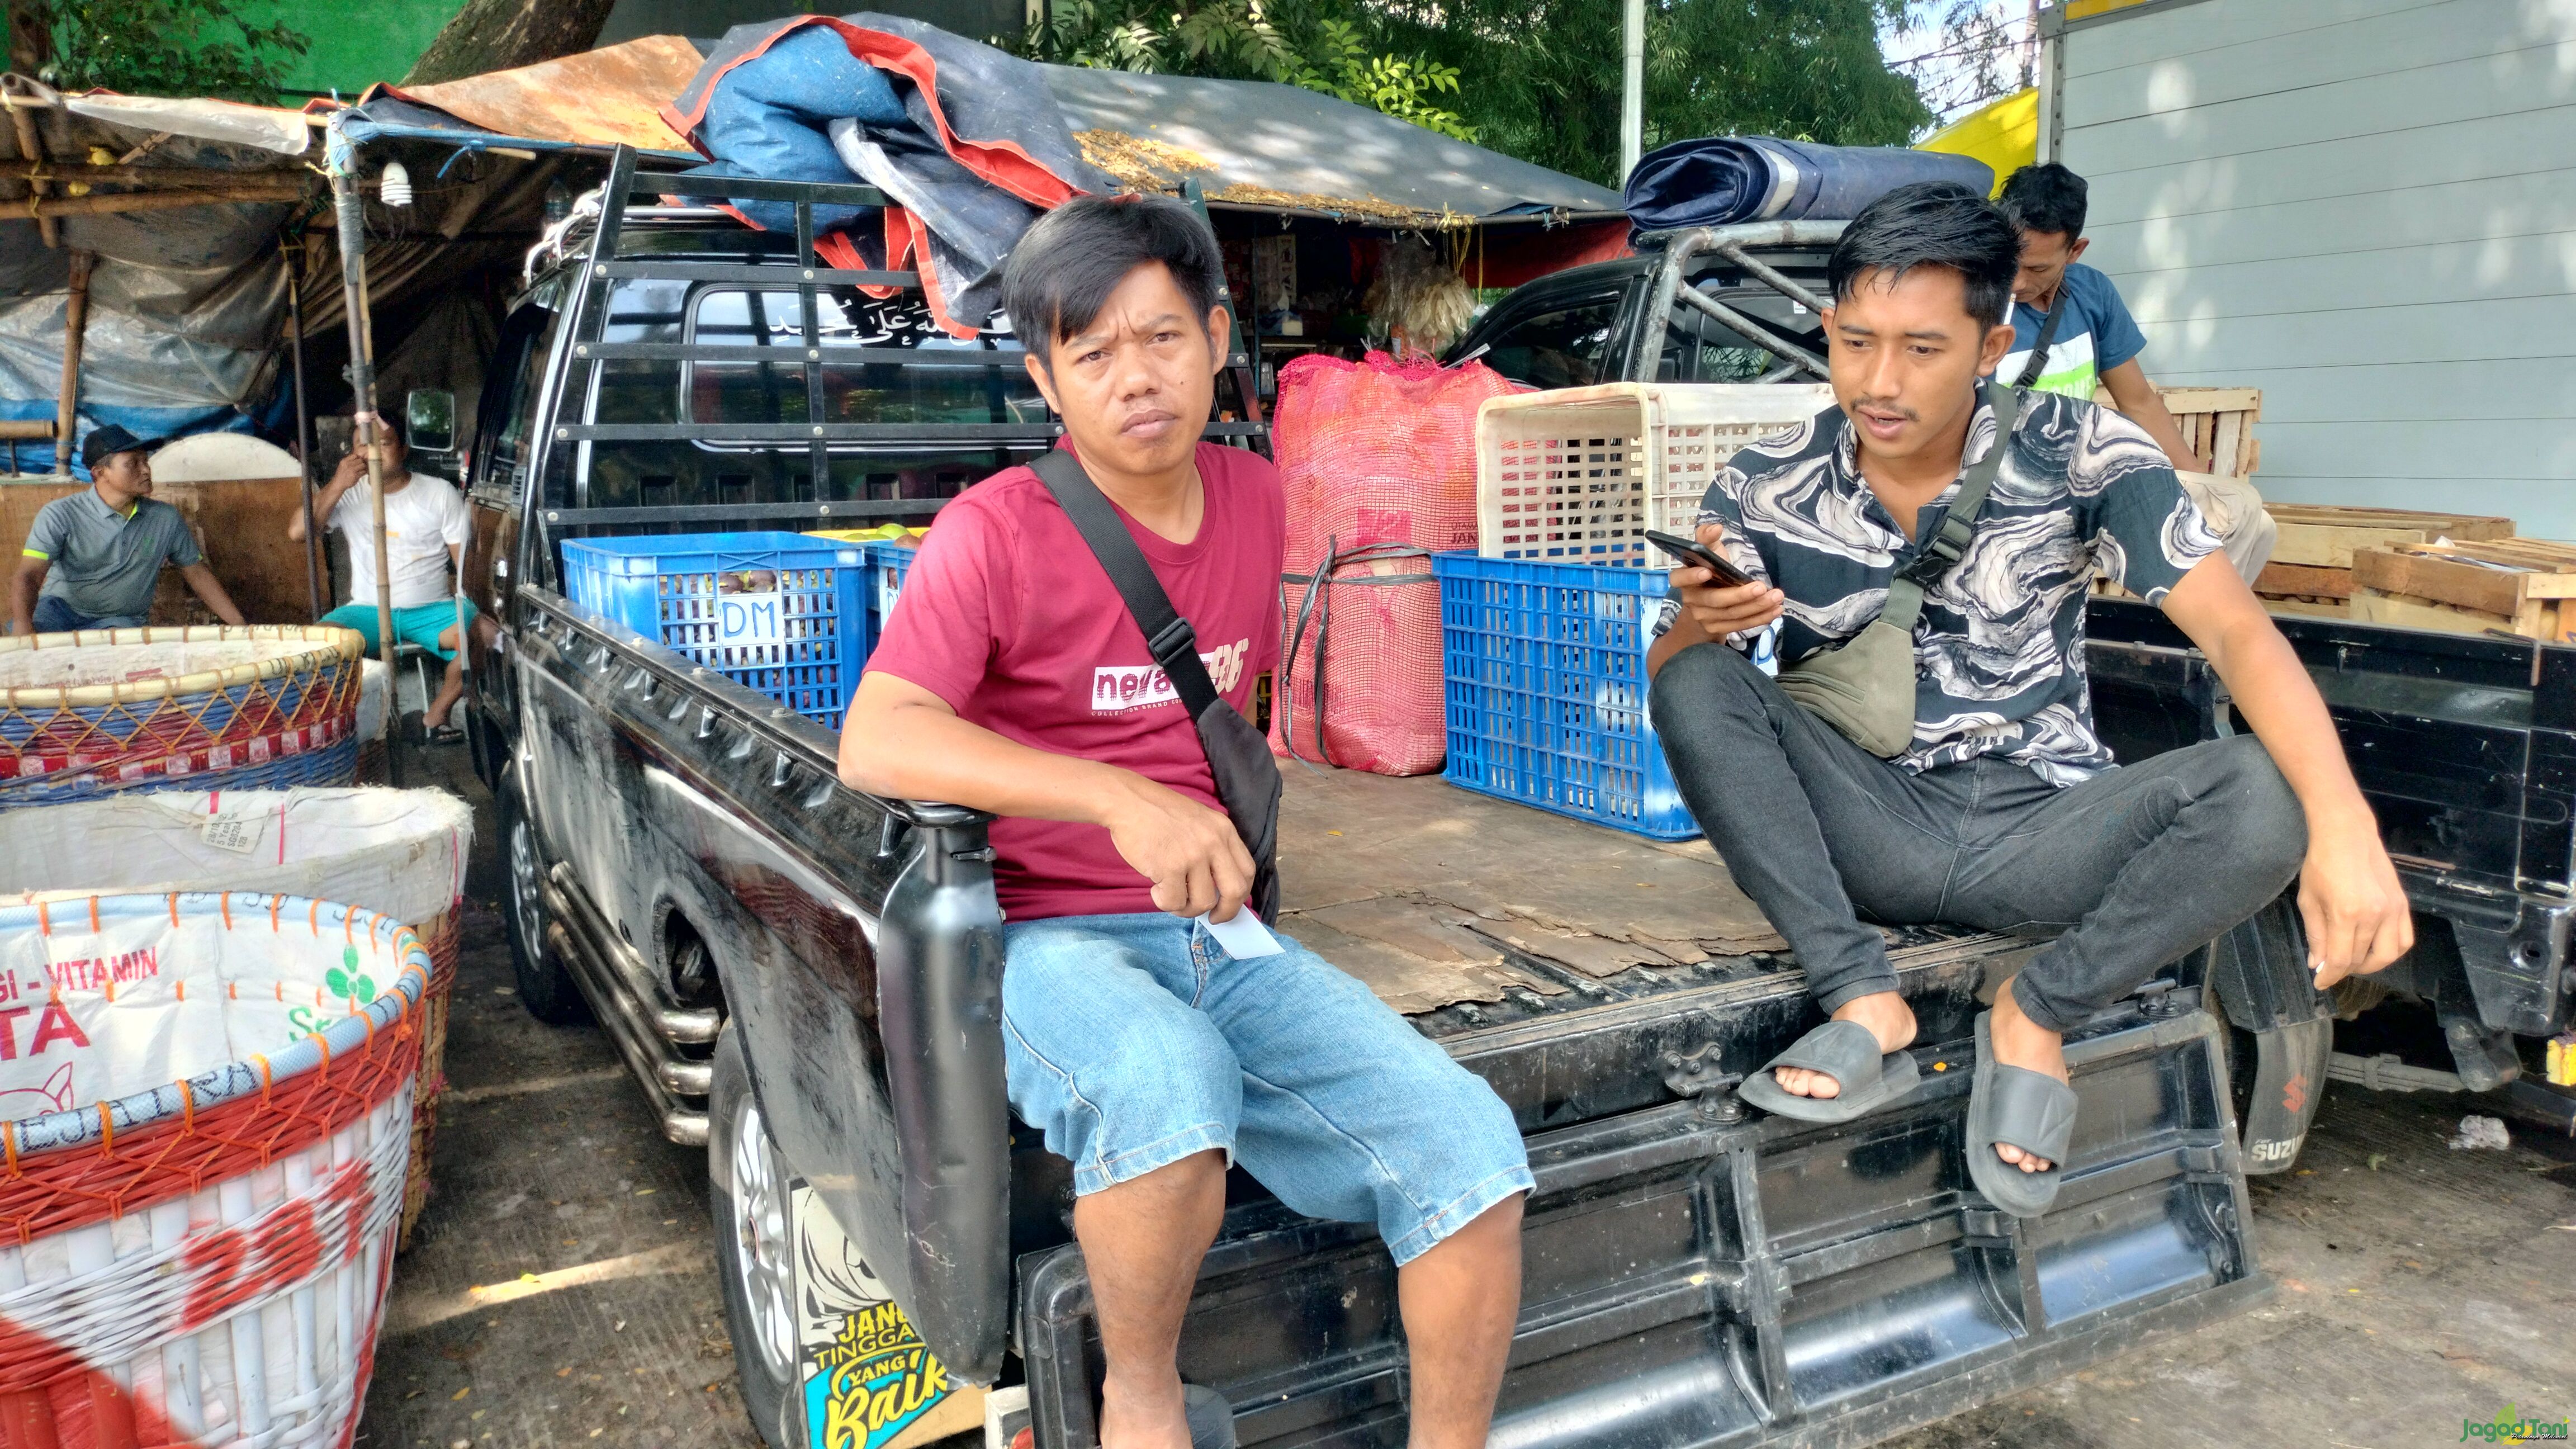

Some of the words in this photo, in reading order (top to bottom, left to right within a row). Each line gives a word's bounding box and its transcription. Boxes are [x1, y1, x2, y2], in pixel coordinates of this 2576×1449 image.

[722, 601, 776, 638] DM
[1091, 707, 1139, 716] COLLECTION
[1142, 701, 1168, 709] BRAND
[813, 1323, 915, 1370] TINGGA
[847, 1355, 906, 1387] YANG
[826, 1349, 948, 1449] Baik
